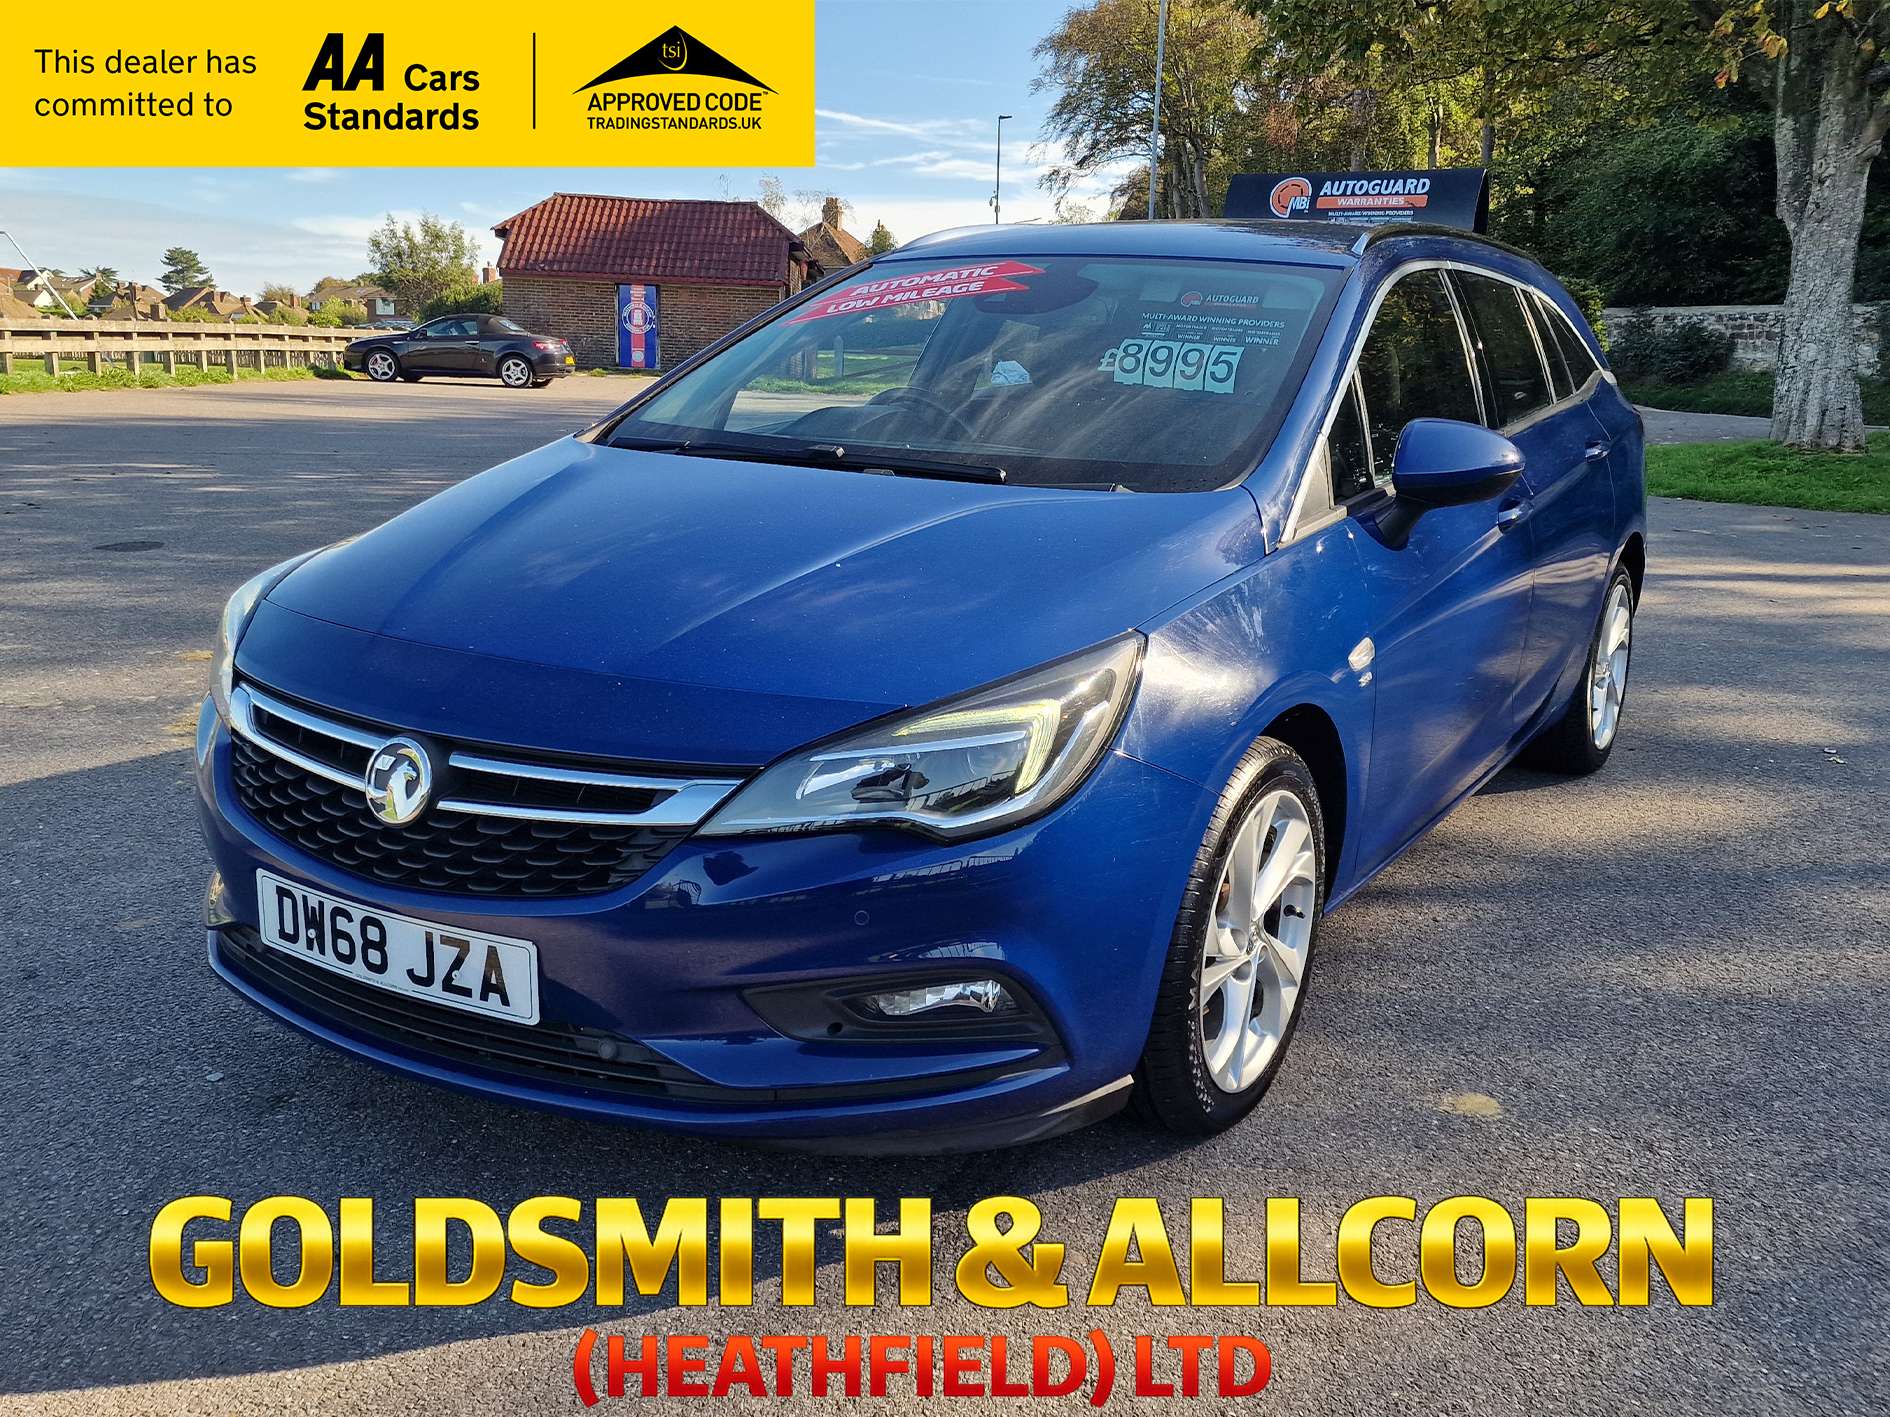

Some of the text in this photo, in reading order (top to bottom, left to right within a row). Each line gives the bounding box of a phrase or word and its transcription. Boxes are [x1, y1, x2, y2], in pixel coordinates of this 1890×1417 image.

[1319, 178, 1431, 196] AUTOGUARD
[1337, 197, 1405, 207] WARRANTIES
[850, 266, 999, 297] AUTOMATIC
[826, 281, 985, 314] LOW MILEAGE
[1205, 294, 1260, 304] AUTOGUARD
[1141, 312, 1286, 329] MULTI-AWARD WINNING PROVIDERS
[1245, 336, 1280, 346] WINNER
[275, 885, 511, 1007] DW68 JZA
